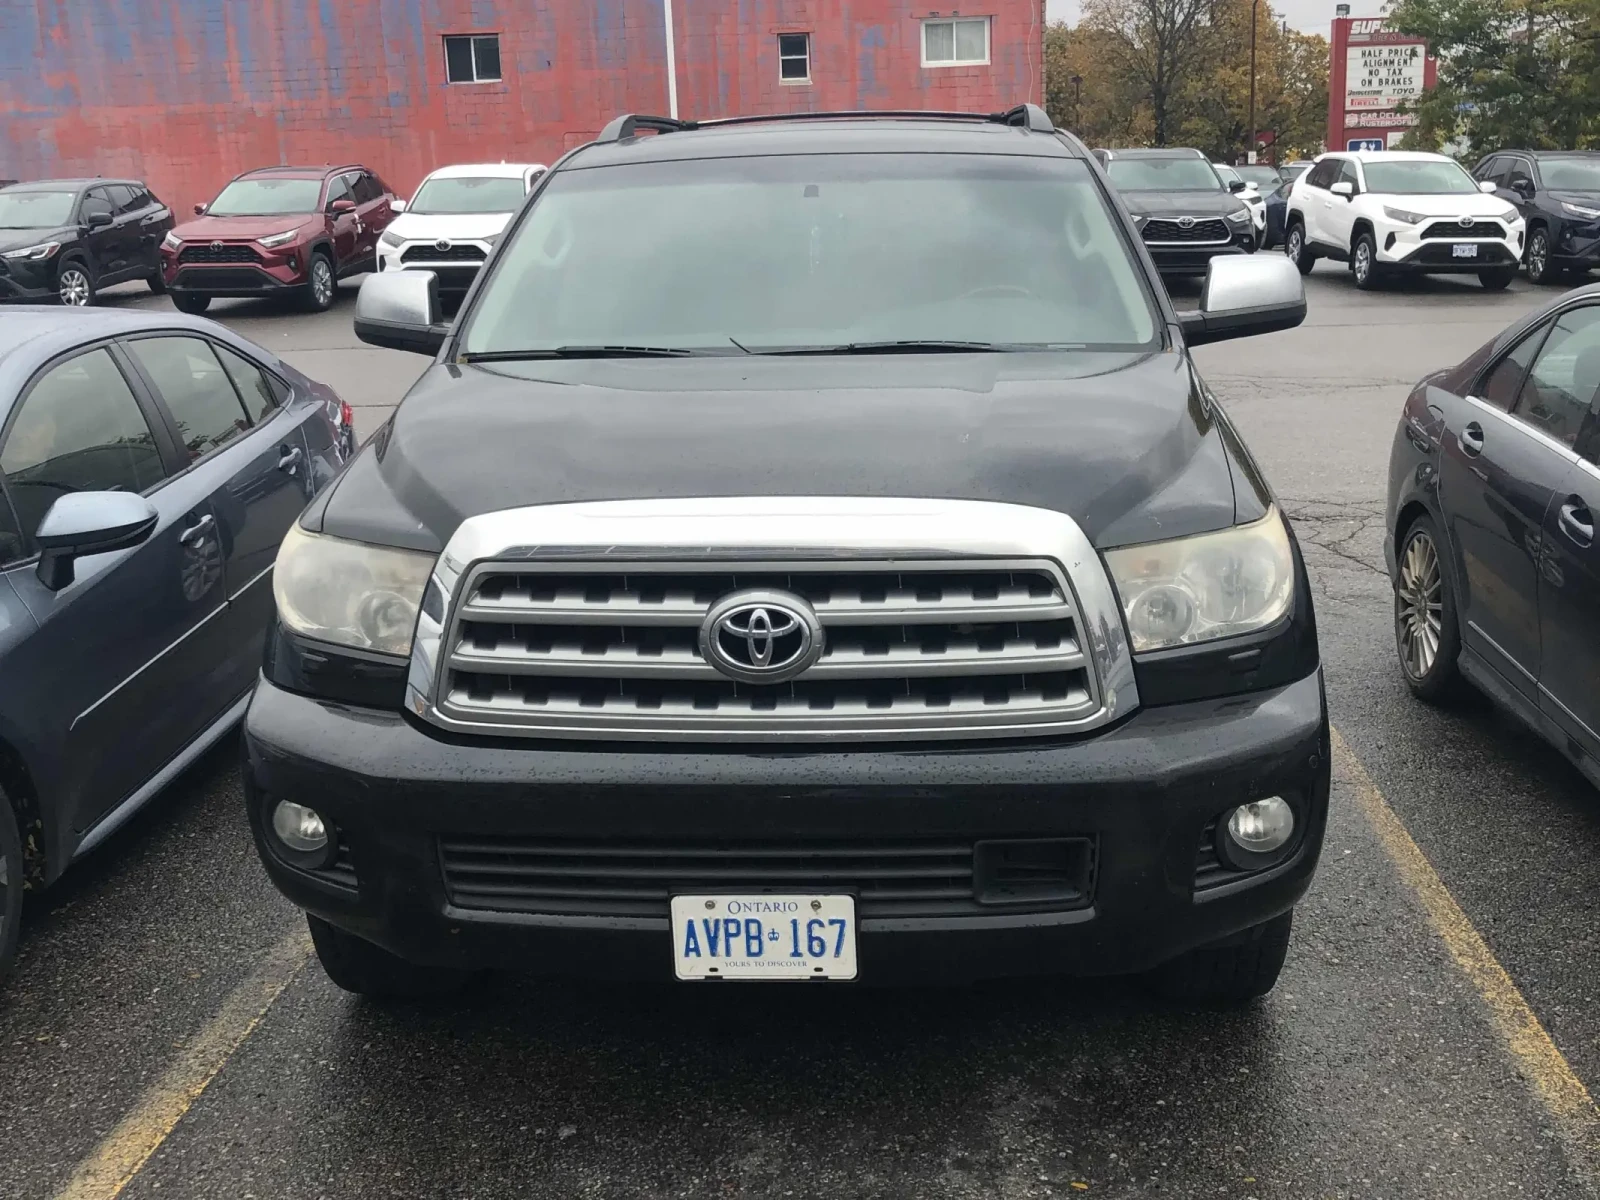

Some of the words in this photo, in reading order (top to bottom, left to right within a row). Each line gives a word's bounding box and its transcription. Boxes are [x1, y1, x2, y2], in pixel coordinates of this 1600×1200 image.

[1361, 49, 1383, 58] HALF
[1363, 59, 1413, 68] ALIGNMENT
[1368, 69, 1380, 77] NO
[1387, 68, 1403, 76] TAX
[1361, 78, 1373, 87] ON
[1379, 77, 1413, 86] BRAKES
[1392, 87, 1415, 95] TOYO
[727, 901, 798, 914] ONTARIO
[684, 918, 765, 958] AVPB
[789, 918, 846, 958] 167
